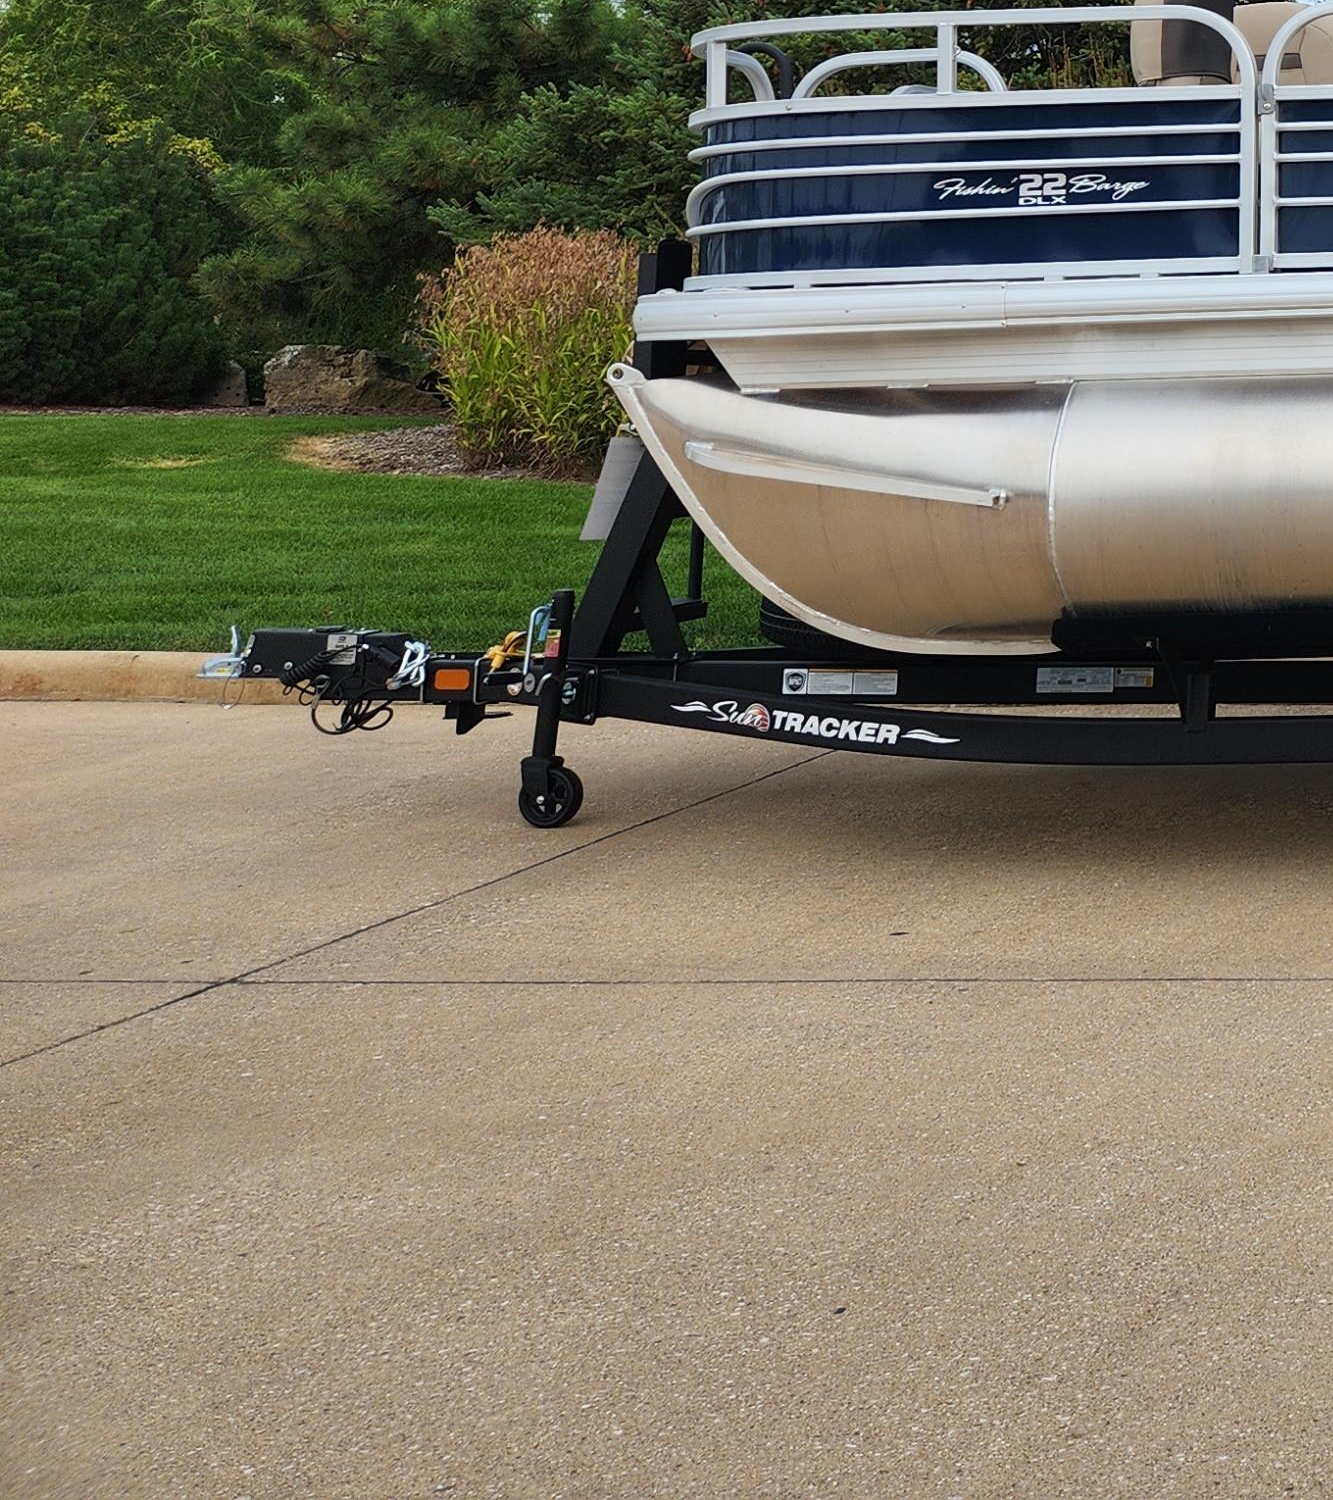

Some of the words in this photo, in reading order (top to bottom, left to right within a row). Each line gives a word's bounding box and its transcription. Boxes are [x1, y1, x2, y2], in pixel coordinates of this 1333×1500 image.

[933, 176, 1018, 200] Fishin'
[1018, 173, 1067, 197] 22
[1068, 173, 1150, 201] Barge
[1018, 196, 1067, 206] DLX
[706, 700, 766, 730] Sun
[771, 709, 901, 745] TRACKER
